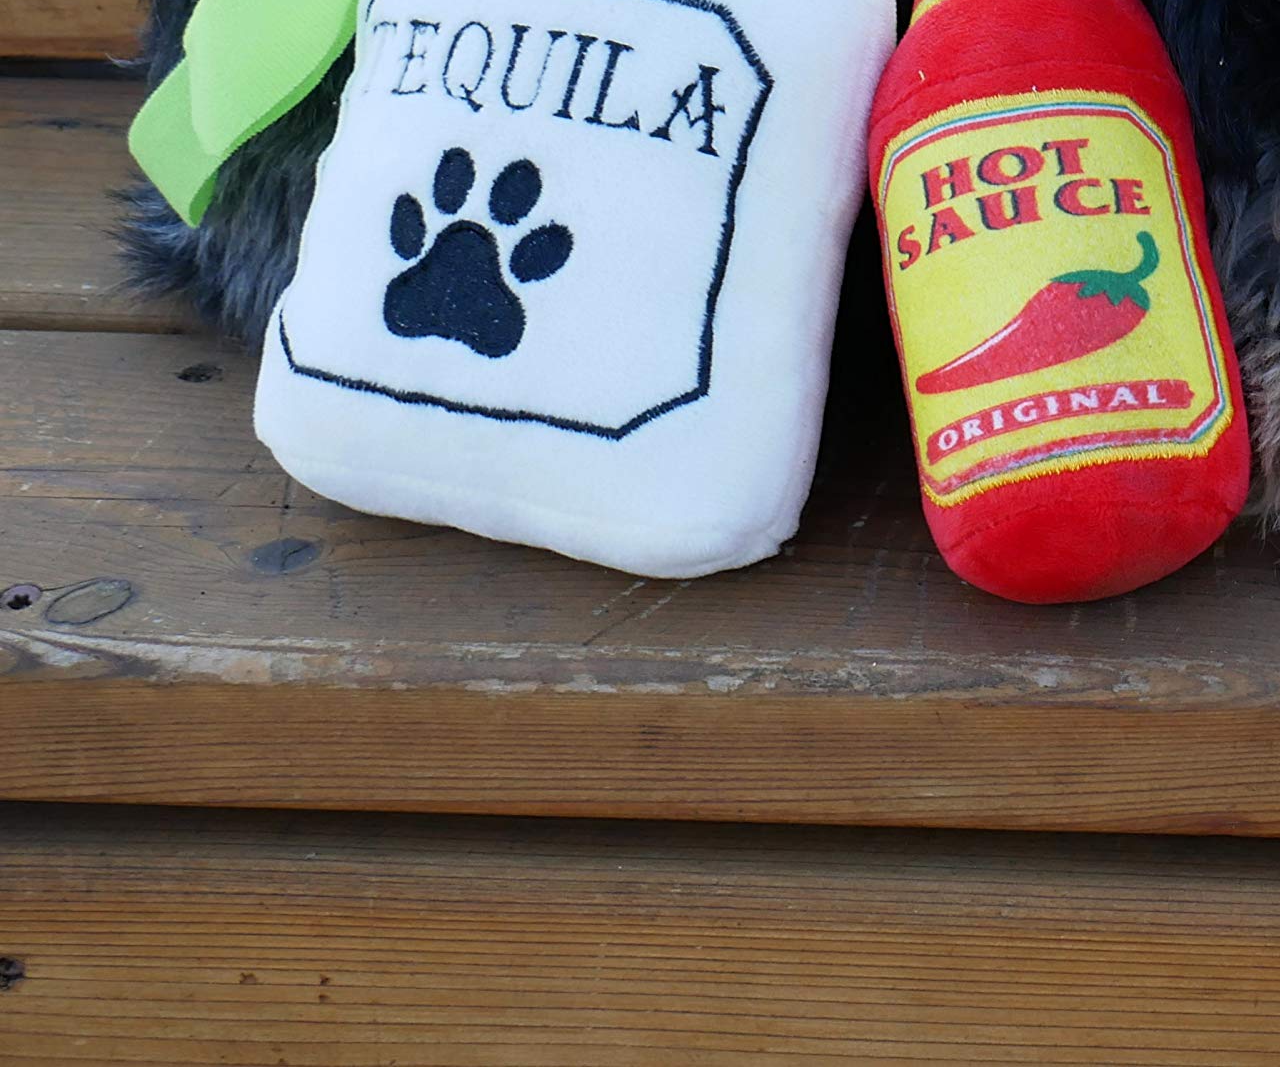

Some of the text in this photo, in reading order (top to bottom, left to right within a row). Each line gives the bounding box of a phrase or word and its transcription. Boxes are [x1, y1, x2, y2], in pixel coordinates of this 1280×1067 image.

[366, 19, 726, 157] TEQUILA
[921, 138, 1089, 210] HOT
[898, 178, 1151, 270] SAUCE
[937, 383, 1168, 451] ORIGINAL
